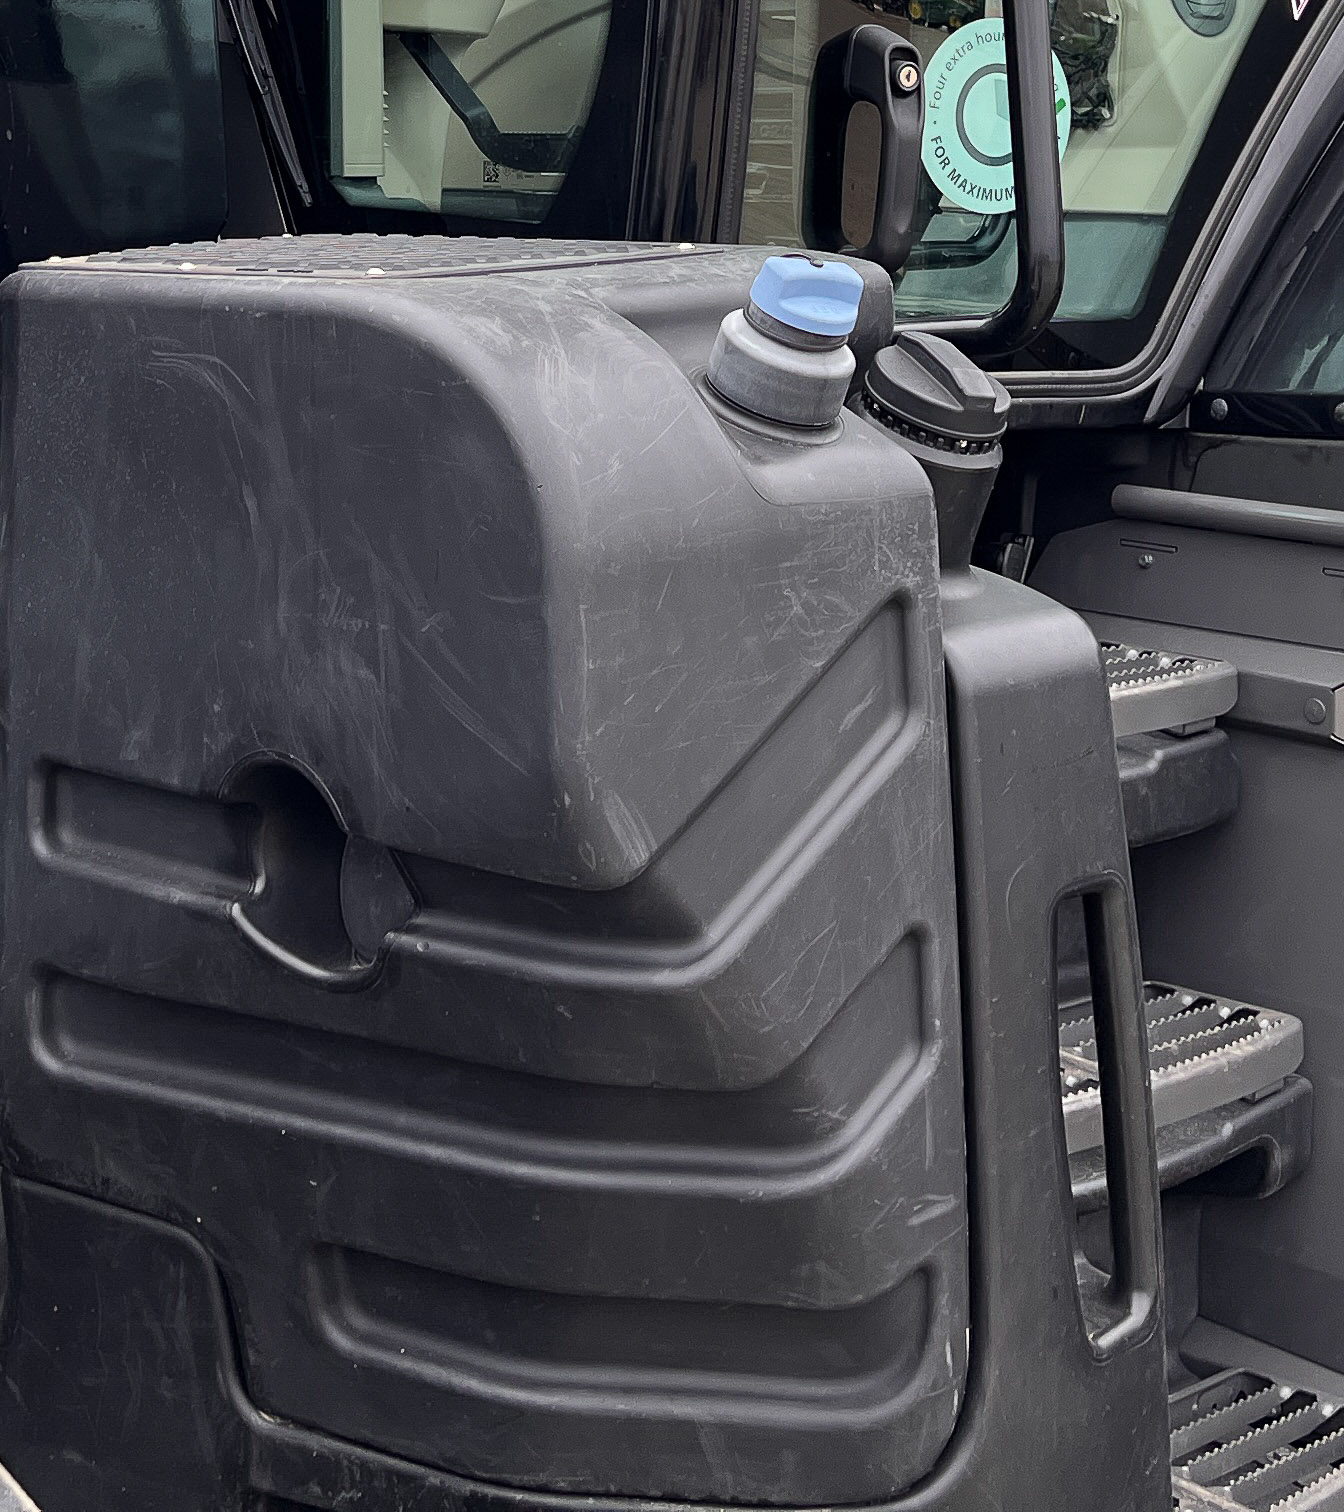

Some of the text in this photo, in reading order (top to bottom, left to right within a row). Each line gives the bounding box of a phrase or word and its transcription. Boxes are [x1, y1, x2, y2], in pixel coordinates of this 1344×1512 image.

[929, 73, 947, 109] Four
[946, 40, 974, 72] extra
[930, 135, 951, 170] FOR
